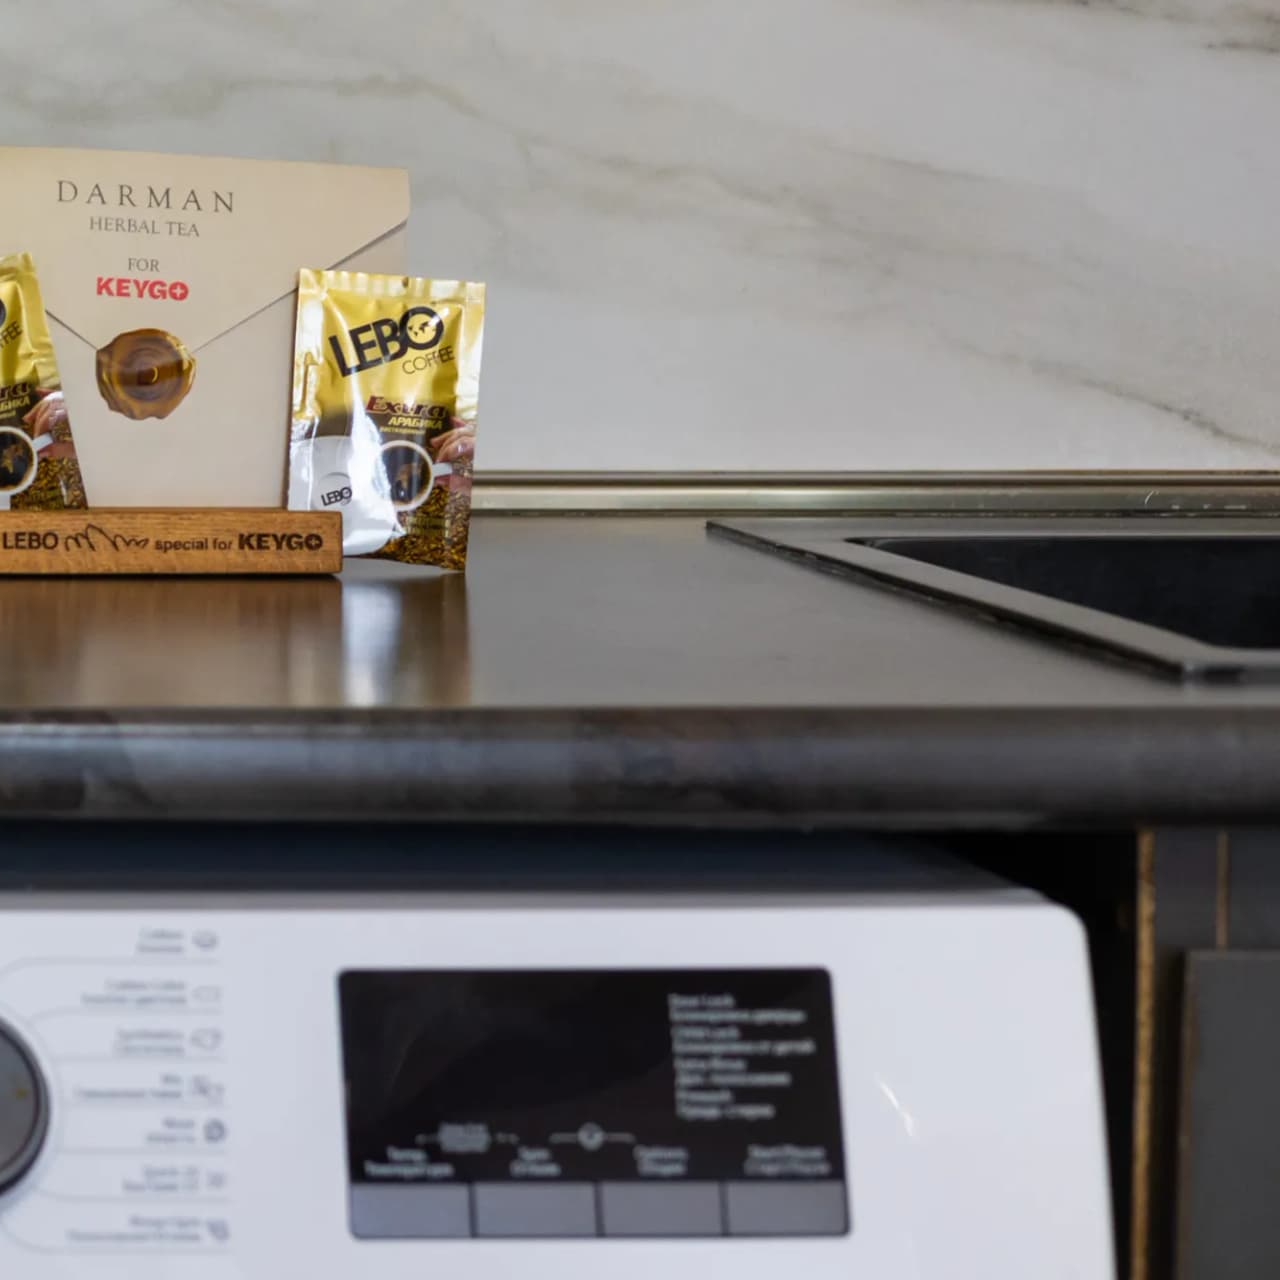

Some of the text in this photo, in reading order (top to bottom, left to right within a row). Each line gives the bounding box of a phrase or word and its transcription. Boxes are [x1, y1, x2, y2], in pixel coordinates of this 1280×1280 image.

[56, 179, 235, 214] DARMAN
[89, 216, 200, 238] HERBAL TEA
[127, 257, 160, 272] FOR
[96, 276, 189, 301] KEYGO
[328, 306, 445, 379] LEBO
[402, 345, 455, 375] COFFEE
[321, 486, 353, 507] LEBO
[2, 531, 324, 553] LEBO special for KEYGO
